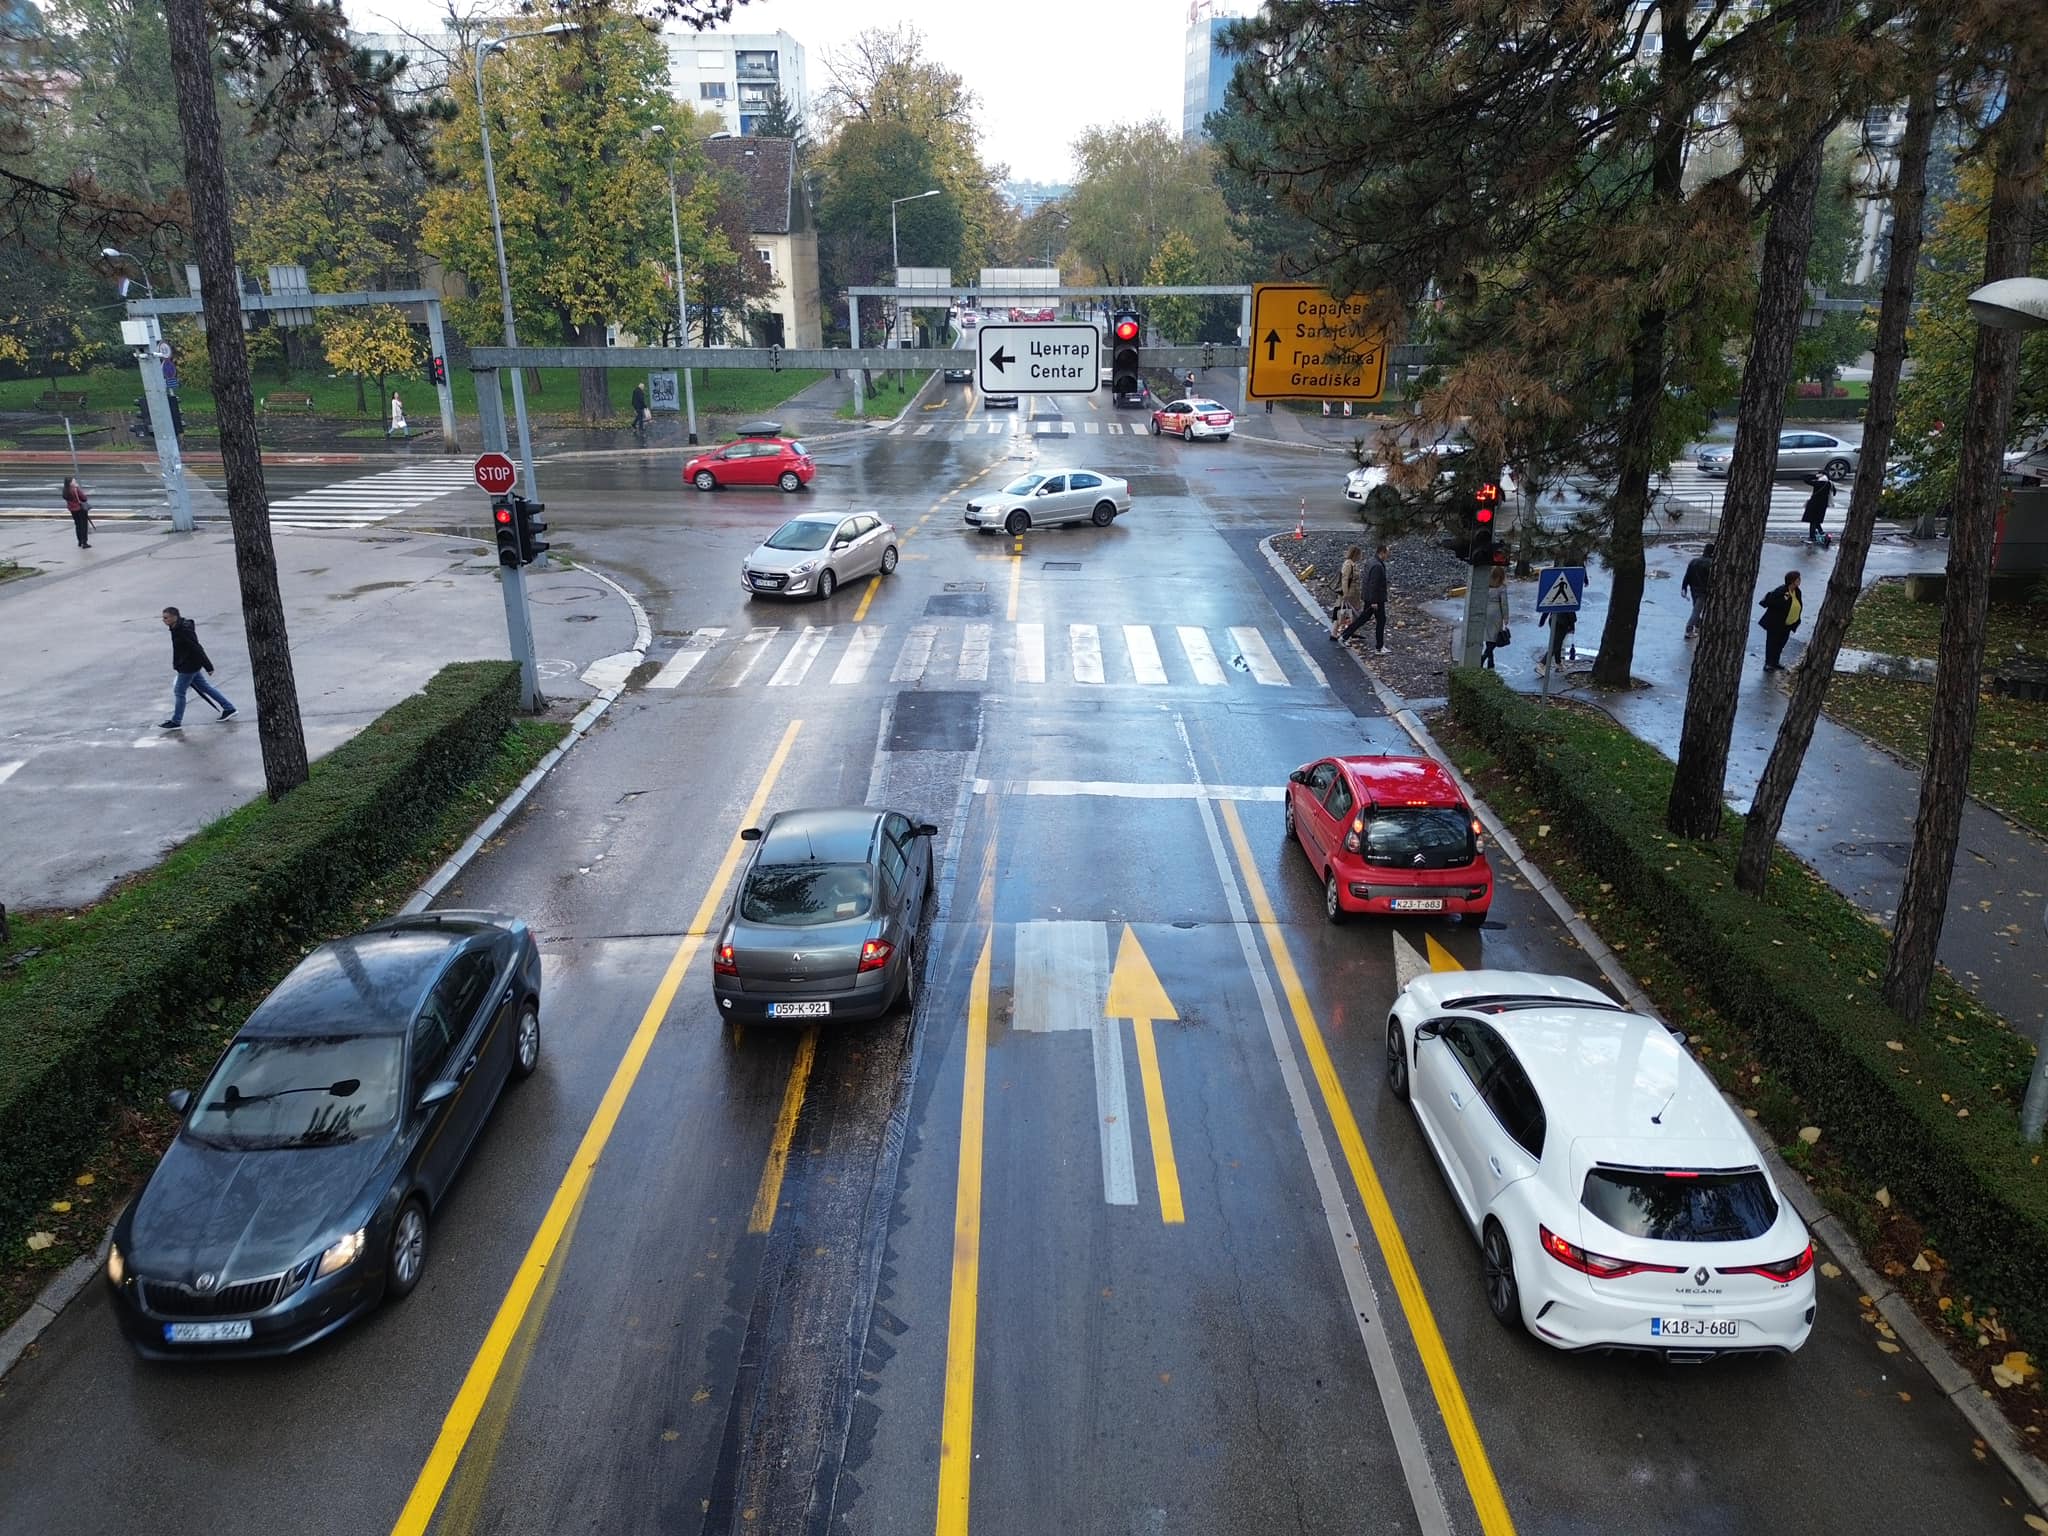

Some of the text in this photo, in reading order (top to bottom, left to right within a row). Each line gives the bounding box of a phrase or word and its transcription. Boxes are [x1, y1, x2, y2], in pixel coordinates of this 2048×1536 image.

[1030, 341, 1090, 359] Центар
[1030, 364, 1084, 378] Centar
[1291, 373, 1361, 386] Gradiška
[479, 467, 510, 480] STOP
[775, 1003, 827, 1014] 059-K-921
[1662, 1320, 1736, 1335] K18-J-680
